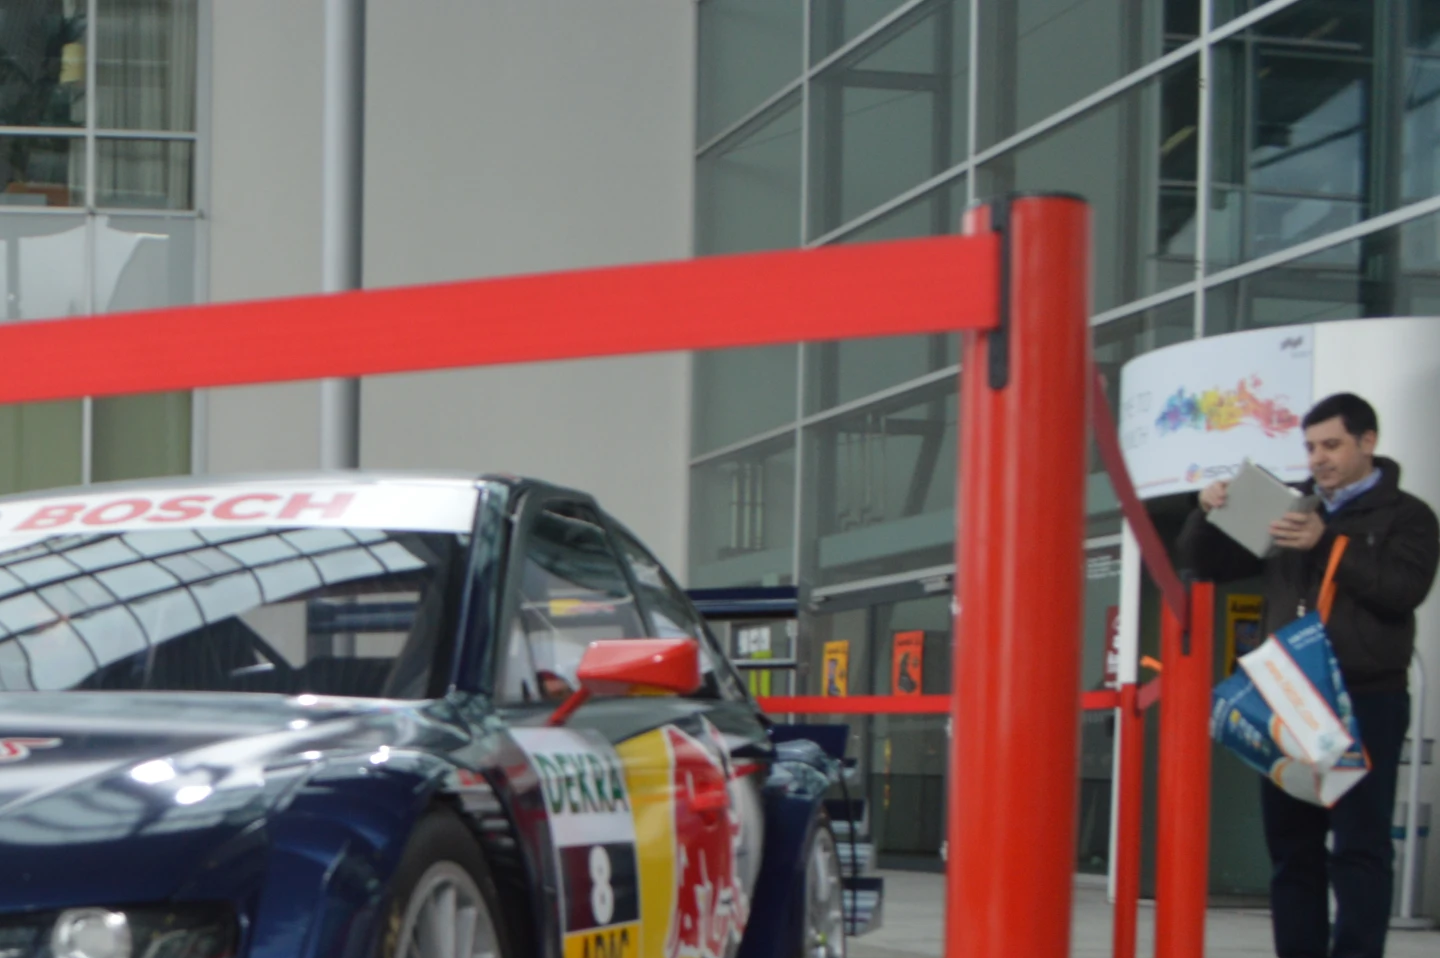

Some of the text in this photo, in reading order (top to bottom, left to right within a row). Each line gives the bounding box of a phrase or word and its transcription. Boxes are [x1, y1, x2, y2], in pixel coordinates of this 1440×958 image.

[13, 492, 356, 533] BOSCH
[533, 753, 630, 814] DEKRA
[589, 845, 614, 925] 8
